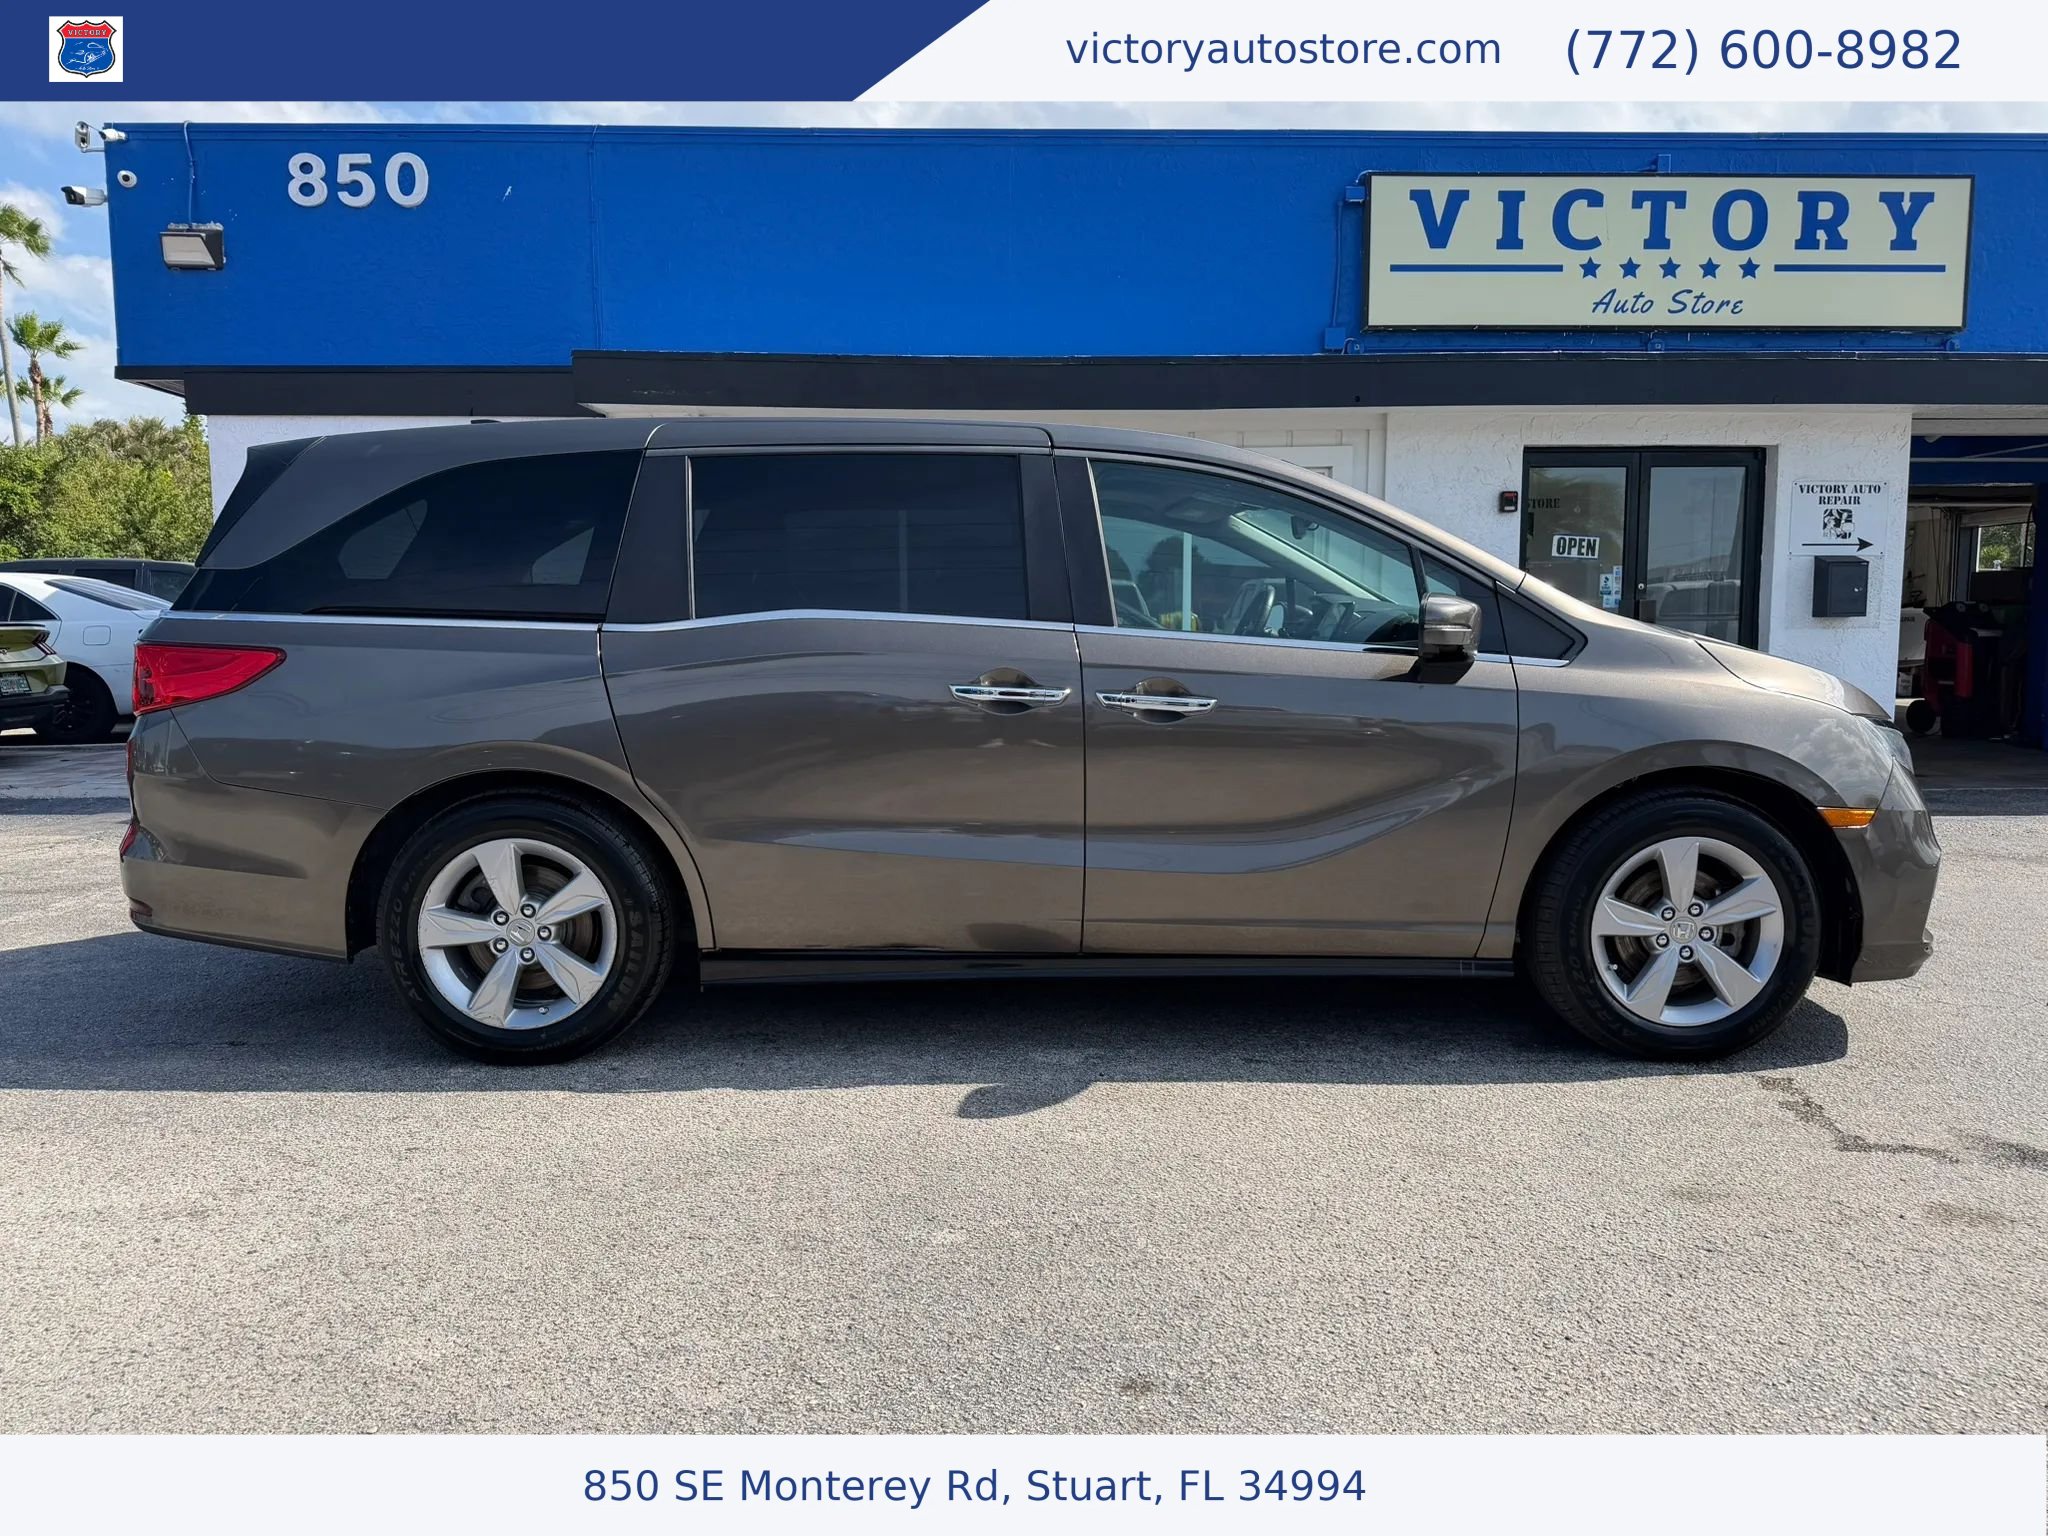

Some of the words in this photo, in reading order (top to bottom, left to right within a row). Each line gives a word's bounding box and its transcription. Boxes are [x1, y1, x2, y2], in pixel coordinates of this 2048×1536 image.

[288, 152, 429, 208] 850
[1408, 188, 1936, 252] VICTORY
[1592, 287, 1655, 315] Auto
[1666, 288, 1744, 315] Store
[1799, 484, 1848, 494] VICTORY
[1851, 484, 1881, 494] AUTO
[1818, 495, 1861, 505] REPAIR
[1527, 498, 1560, 509] TORE
[1556, 536, 1597, 557] OPEN
[388, 897, 423, 1002] ATREZZO
